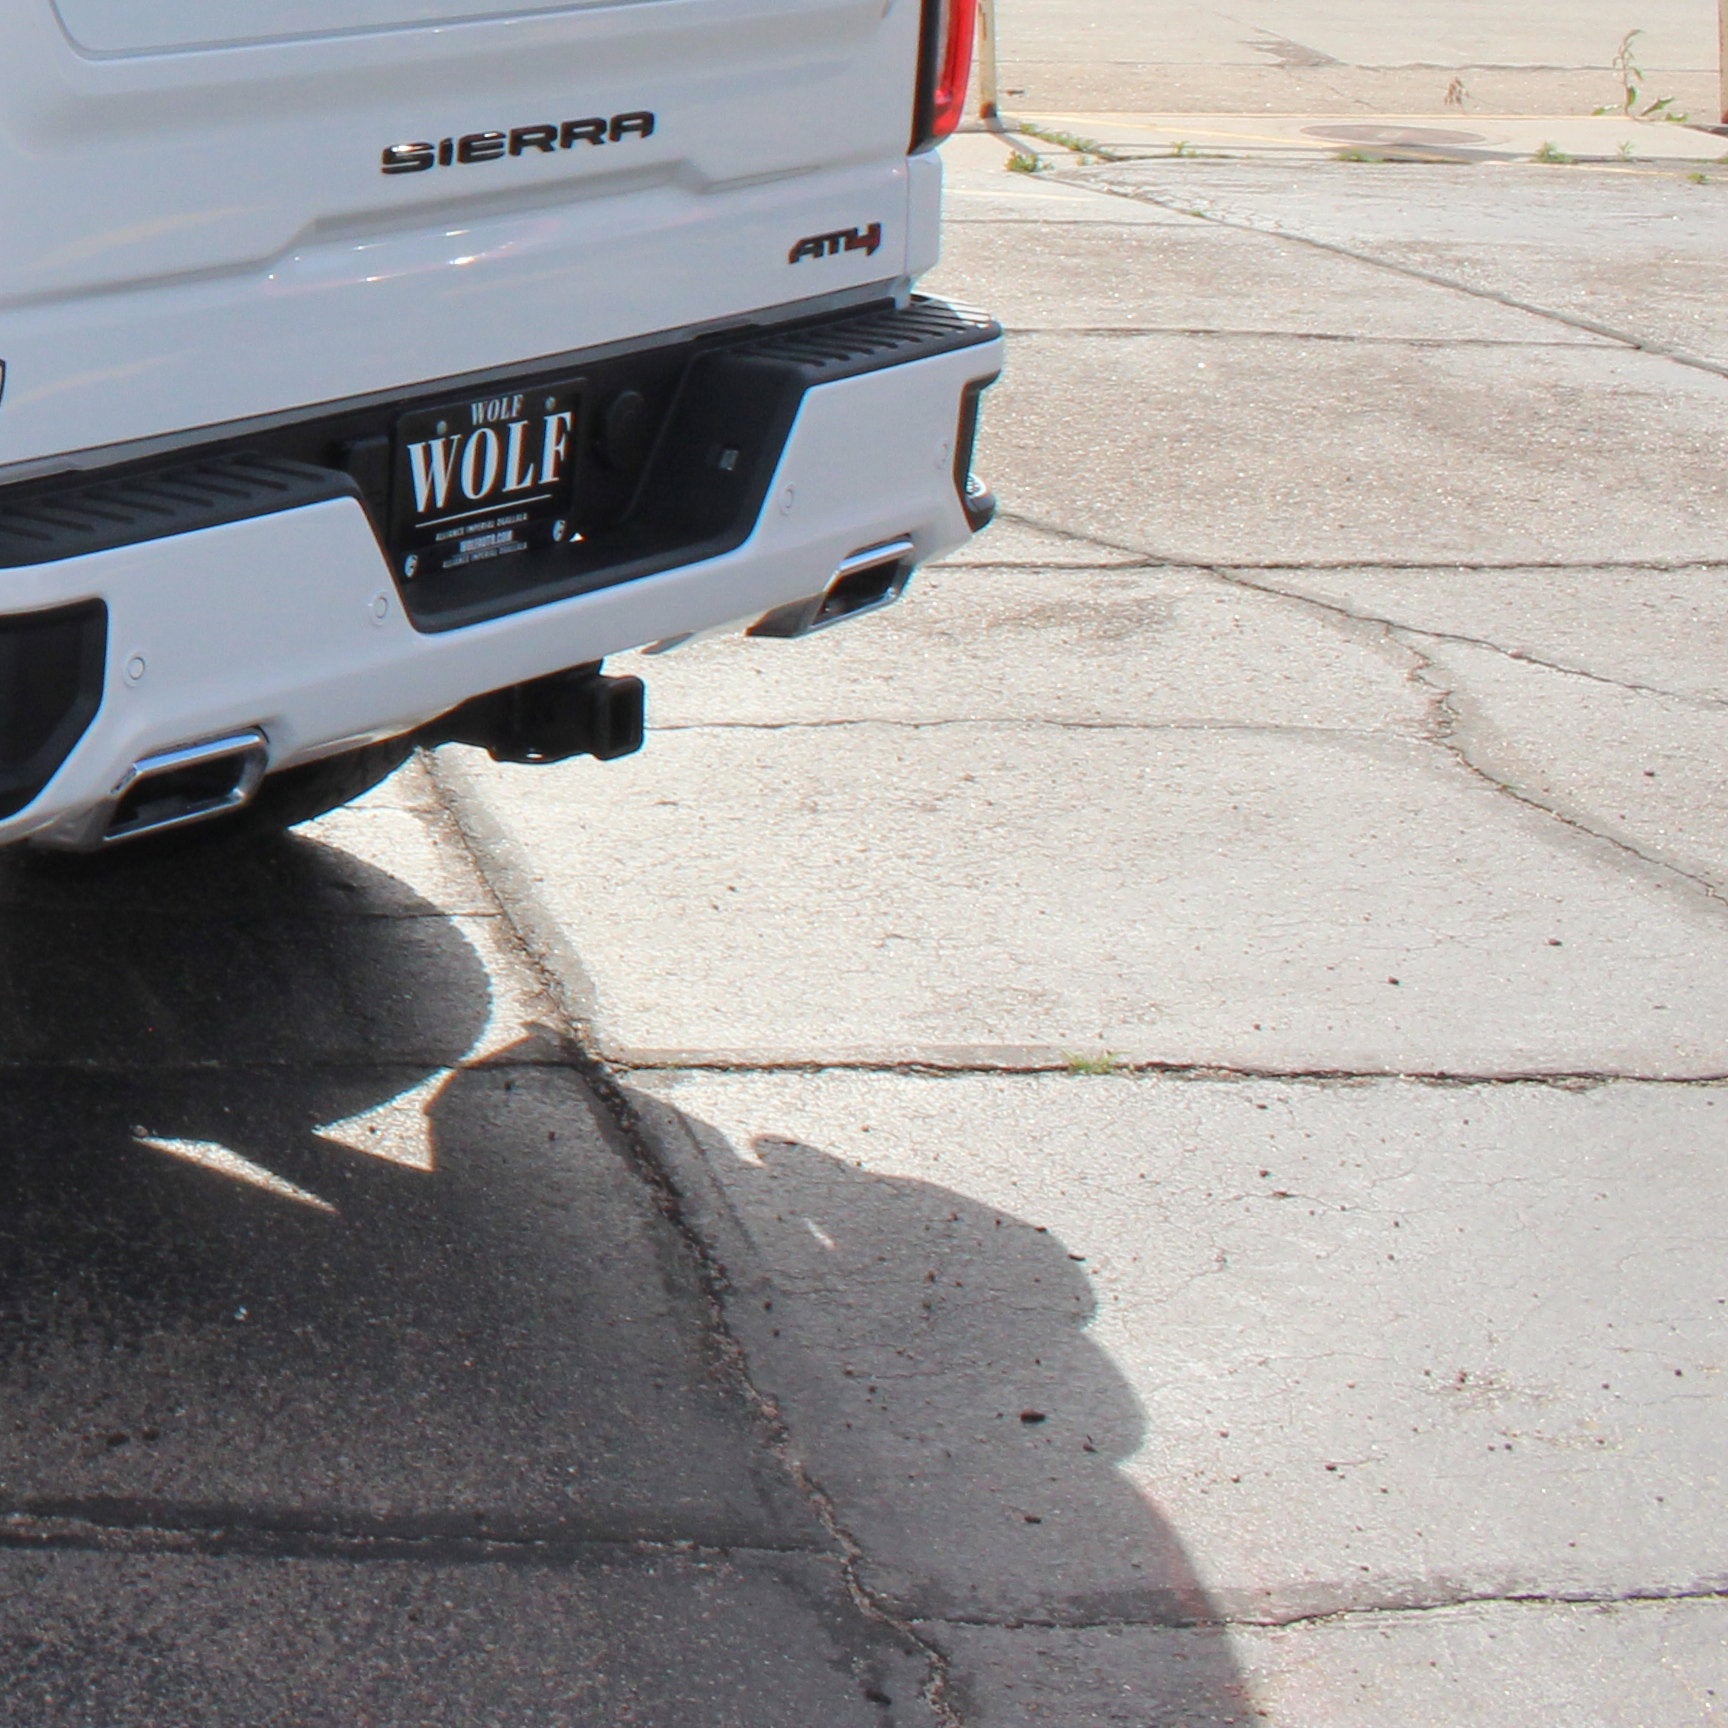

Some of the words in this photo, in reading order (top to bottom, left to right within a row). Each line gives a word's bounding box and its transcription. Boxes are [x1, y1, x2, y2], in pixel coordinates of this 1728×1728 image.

[381, 110, 656, 175] SIERRA
[788, 222, 882, 264] AT4
[470, 394, 524, 425] WOLF
[407, 411, 572, 513] WOLF
